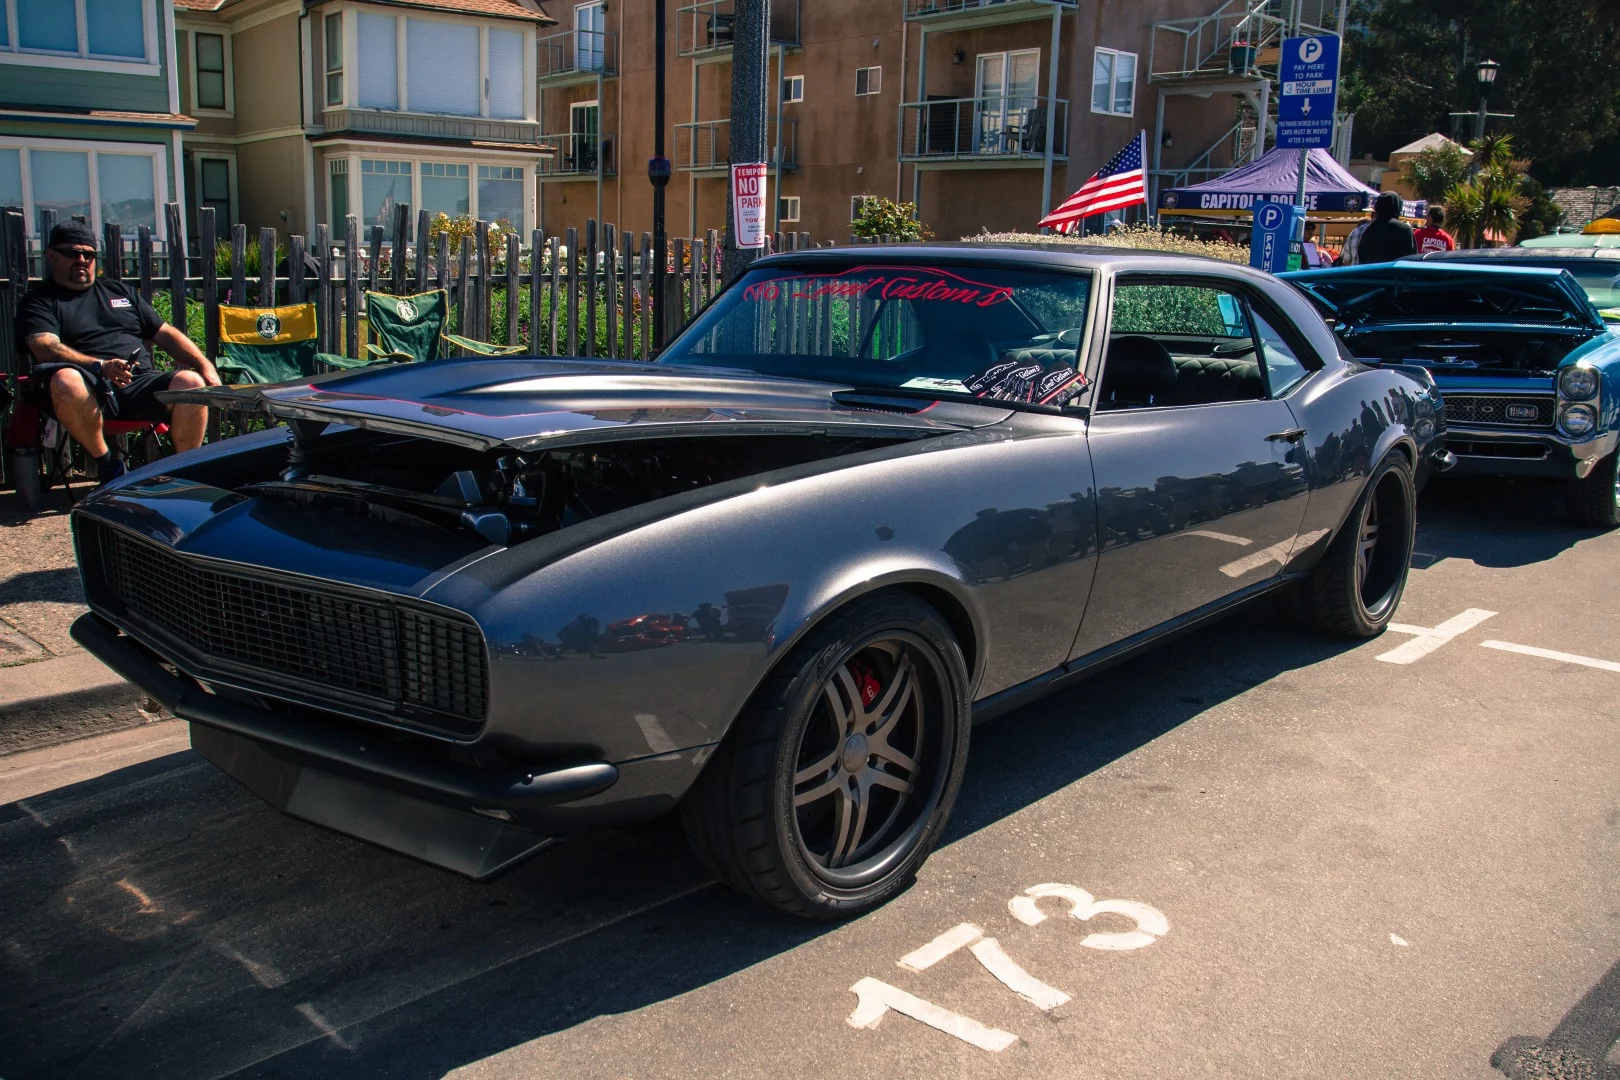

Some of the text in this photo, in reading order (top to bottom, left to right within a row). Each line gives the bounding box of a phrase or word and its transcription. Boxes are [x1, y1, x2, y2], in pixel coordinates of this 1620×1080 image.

[1285, 84, 1293, 94] 3
[739, 177, 758, 194] NO
[1265, 209, 1277, 226] P
[846, 882, 1171, 1053] 173
